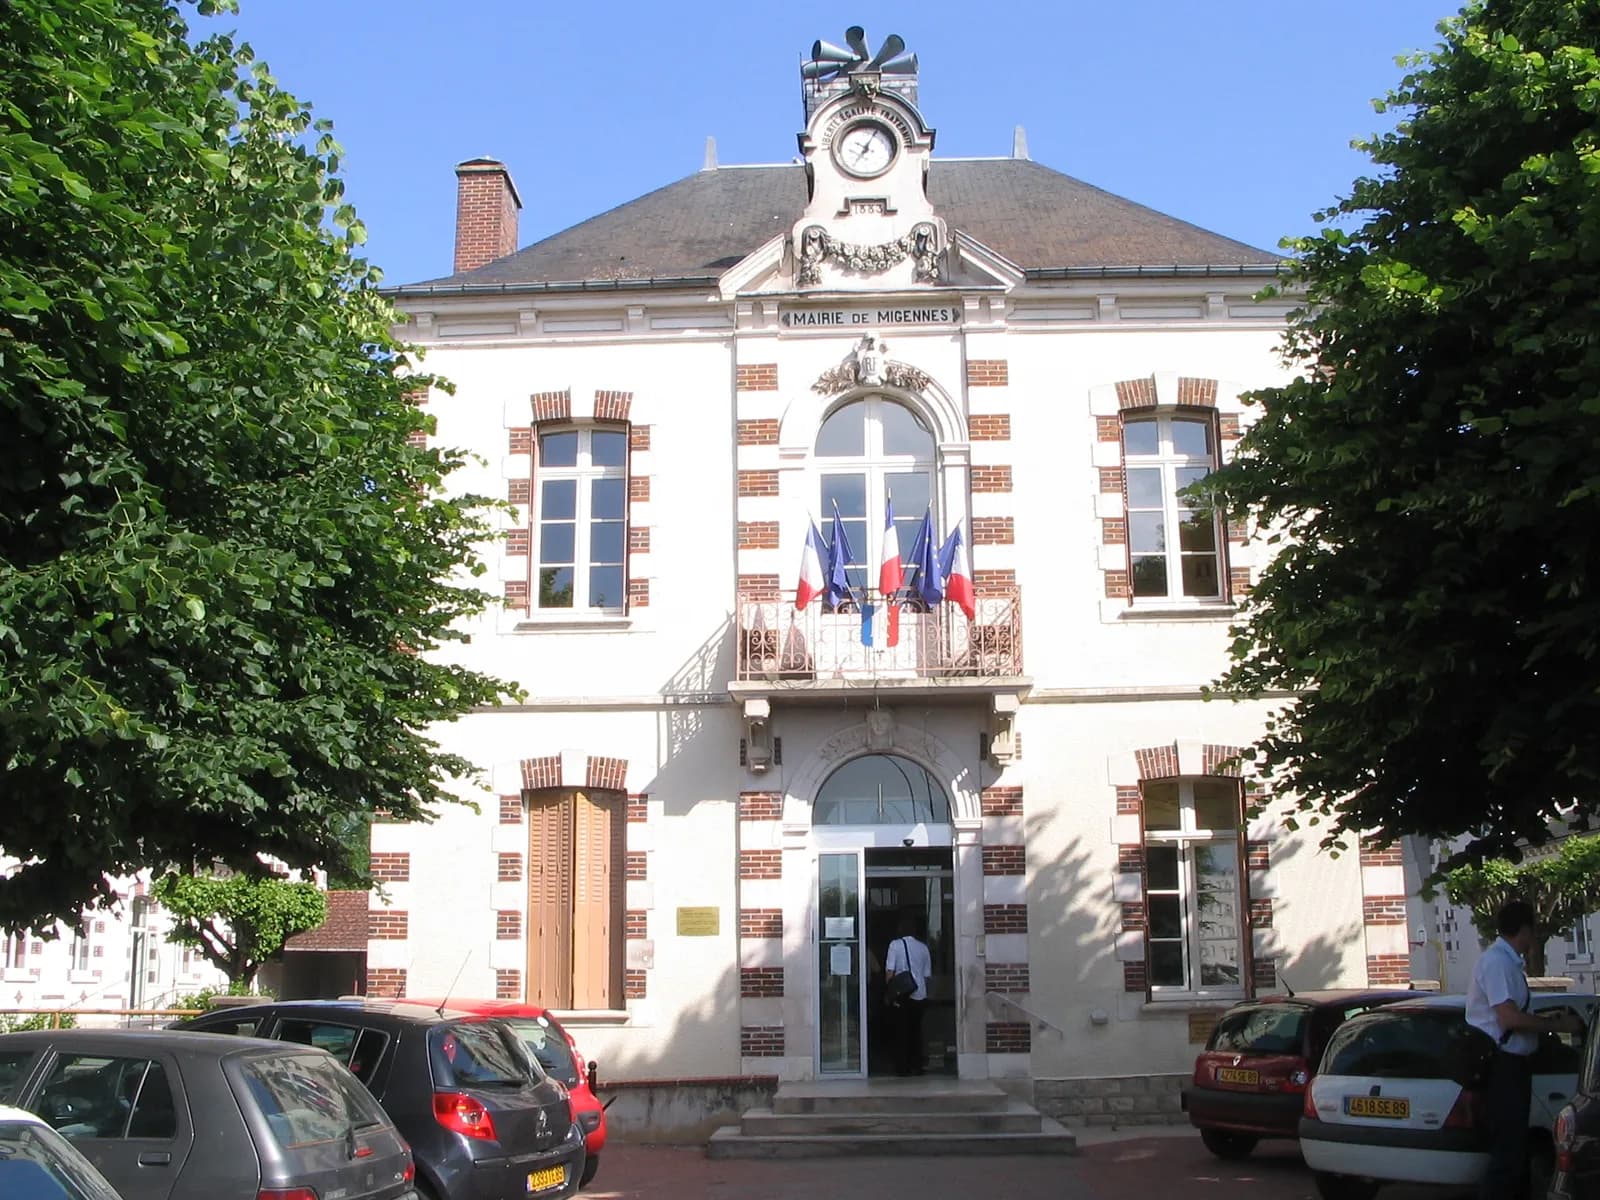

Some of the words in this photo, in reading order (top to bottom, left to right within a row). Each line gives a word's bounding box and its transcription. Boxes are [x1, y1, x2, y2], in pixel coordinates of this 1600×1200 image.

[793, 312, 844, 325] MAIRIE
[852, 313, 869, 324] DE
[877, 309, 949, 324] MIGENNES
[1350, 1100, 1375, 1114] 4618
[1376, 1101, 1390, 1114] SE
[1392, 1102, 1407, 1115] 89
